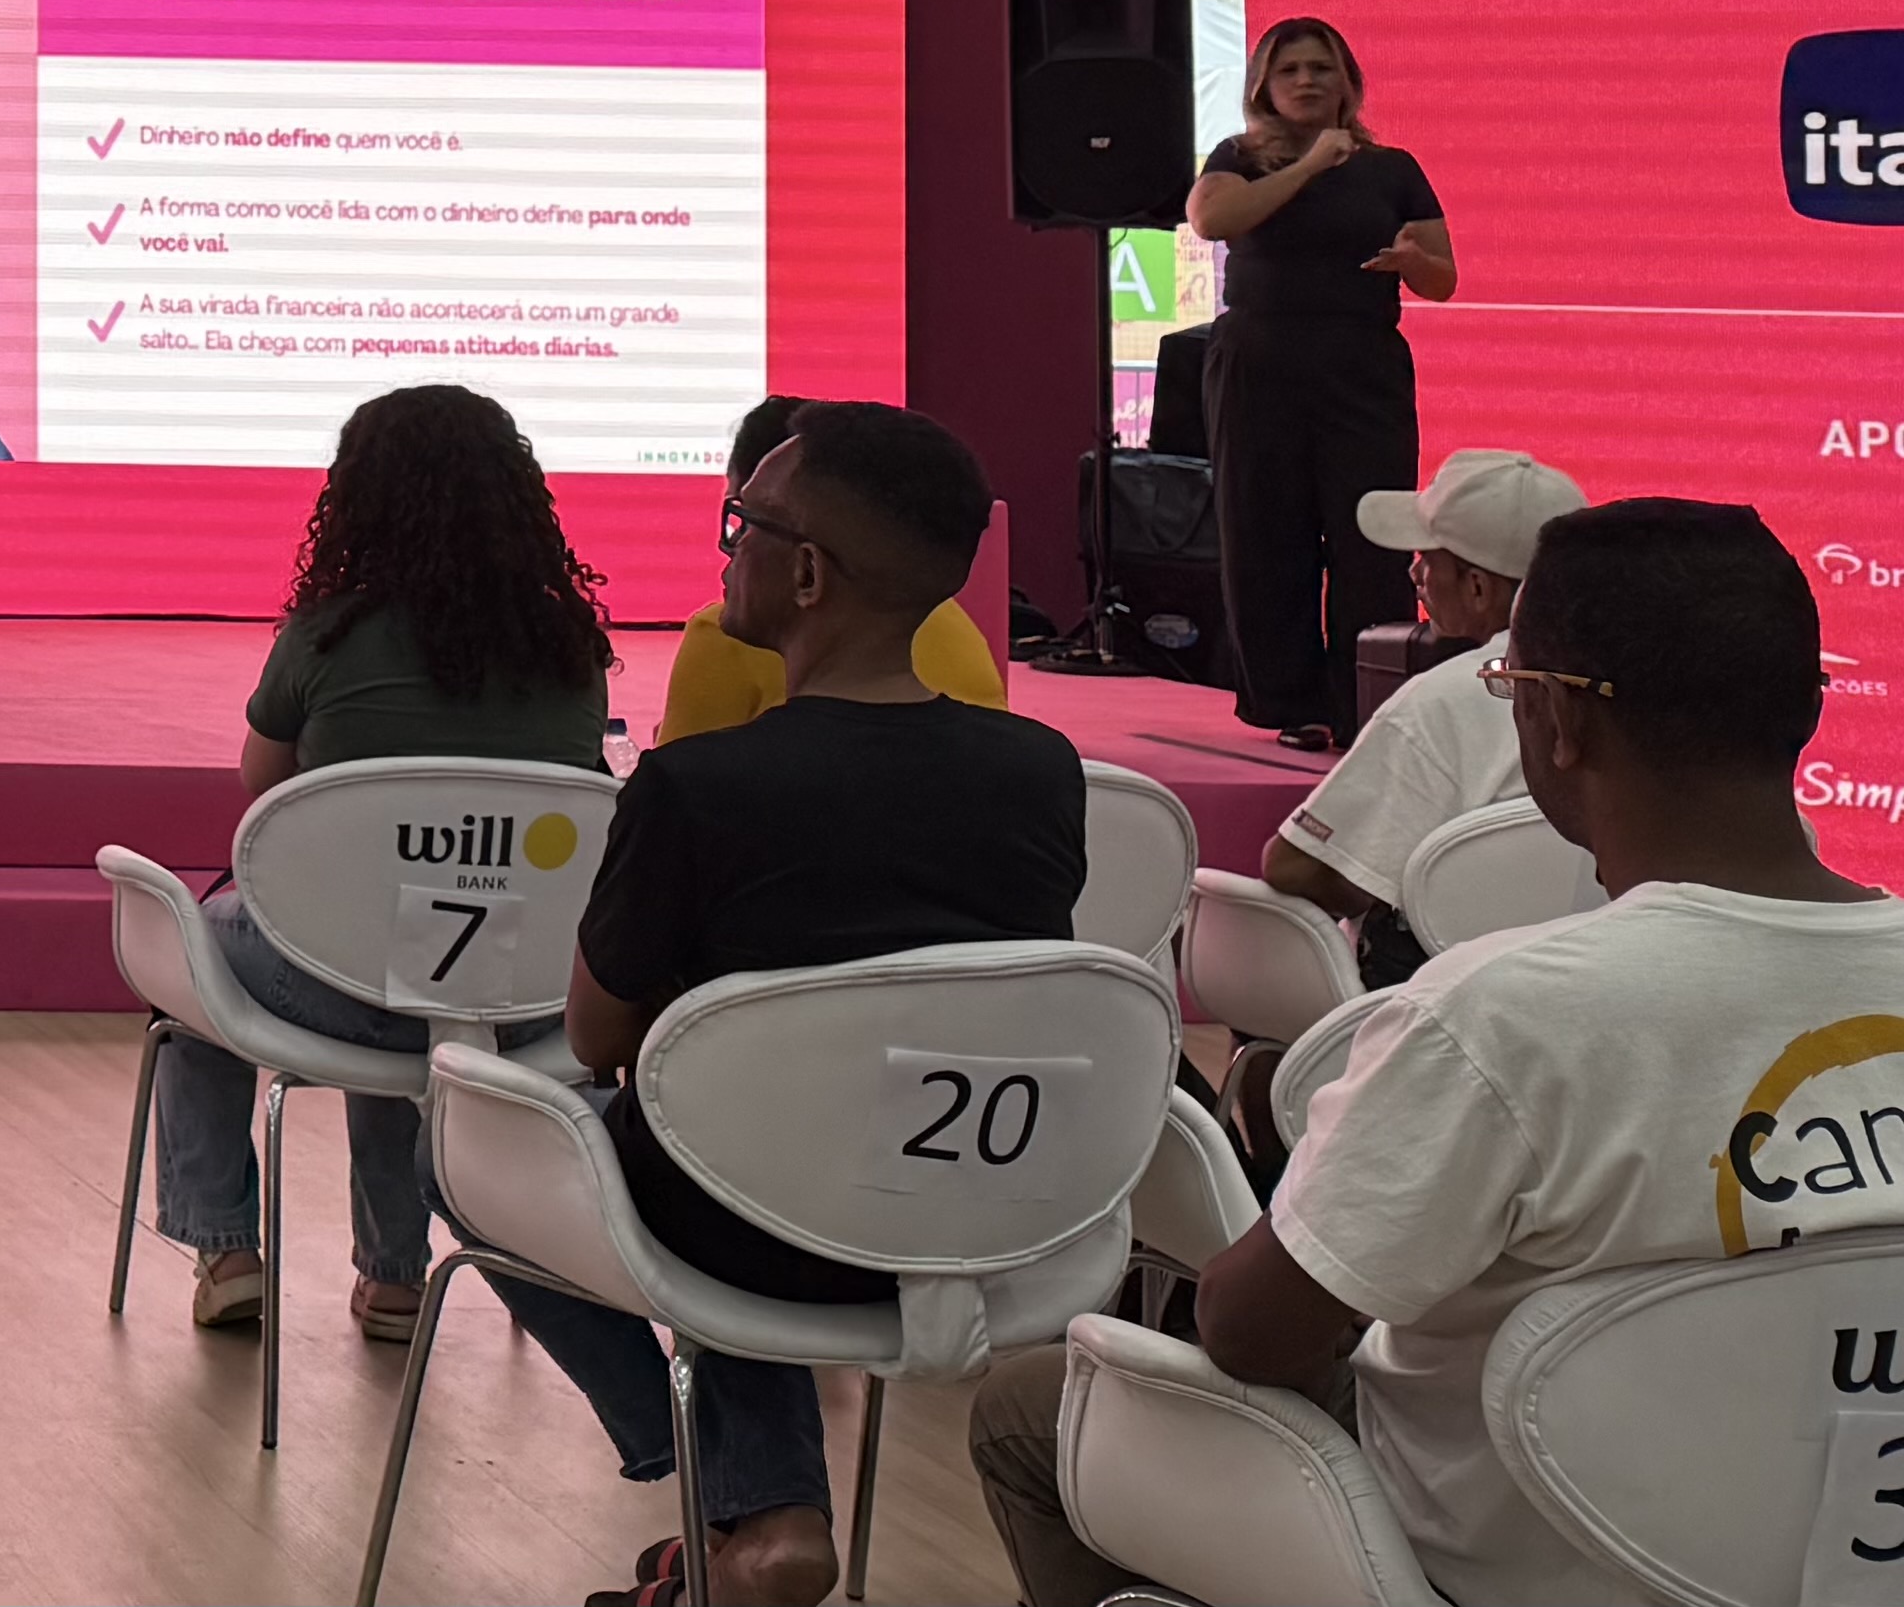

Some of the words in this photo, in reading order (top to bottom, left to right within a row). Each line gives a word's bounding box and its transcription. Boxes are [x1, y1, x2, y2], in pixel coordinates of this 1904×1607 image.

[140, 125, 219, 145] Dinheiro
[225, 127, 262, 146] não
[267, 128, 330, 147] define
[336, 135, 390, 153] quem
[396, 132, 441, 150] você
[1804, 112, 1904, 186] ita
[140, 198, 153, 215] A
[159, 197, 219, 217] forma
[226, 202, 280, 218] como
[286, 199, 332, 219] você
[338, 200, 369, 219] lida
[376, 205, 417, 220] com
[424, 206, 436, 221] o
[442, 203, 518, 223] dinheiro
[523, 205, 583, 223] define
[589, 210, 636, 228] para
[642, 206, 690, 225] onde
[140, 233, 189, 252] você
[194, 233, 229, 252] vai.
[140, 294, 153, 313] A
[160, 298, 192, 313] sua
[200, 294, 259, 315] virada
[267, 295, 362, 317] financeira
[369, 298, 404, 318] não
[411, 300, 523, 320] acontecerá
[529, 305, 571, 321] com
[576, 306, 604, 321] um
[610, 303, 679, 327] grande
[206, 330, 232, 350] Ela
[239, 330, 297, 357] chega
[304, 337, 345, 351] com
[352, 338, 449, 357] pequenas
[454, 335, 539, 355] atitudes
[545, 337, 618, 357] diárias.
[397, 815, 514, 867] will
[457, 875, 508, 890] BANK
[430, 900, 487, 982] 7
[902, 1070, 1039, 1165] 20
